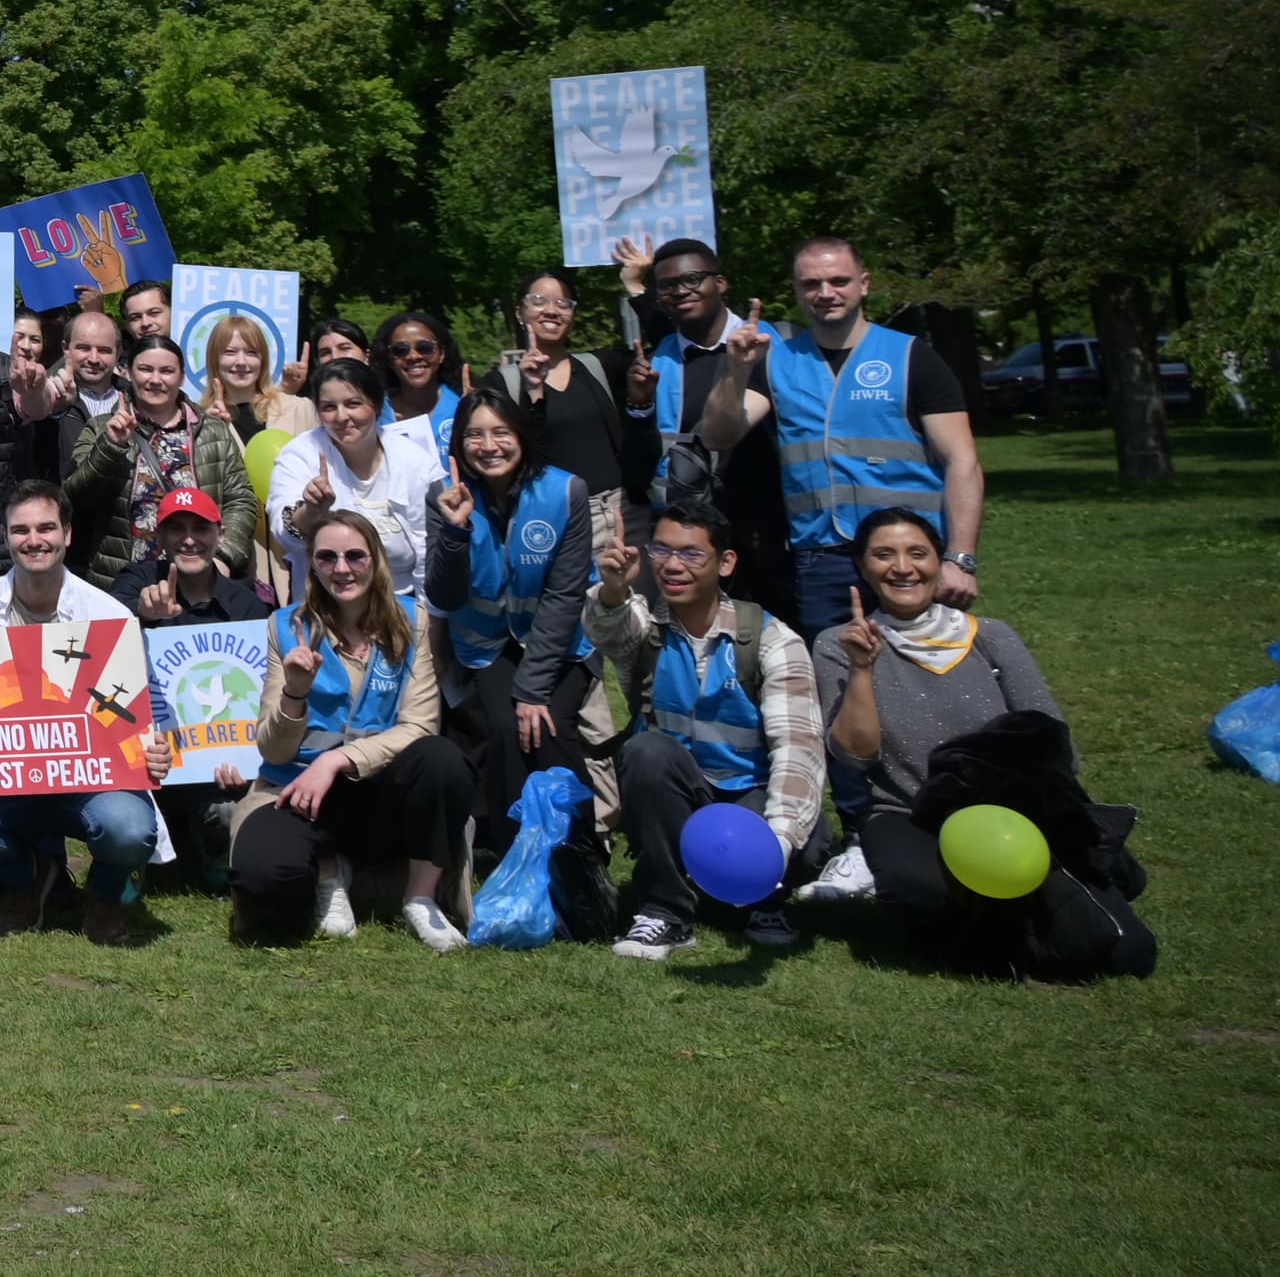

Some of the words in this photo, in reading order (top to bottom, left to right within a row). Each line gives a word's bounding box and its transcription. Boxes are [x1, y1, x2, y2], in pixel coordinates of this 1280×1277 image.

[179, 269, 291, 311] PEACE
[850, 389, 895, 401] HWPL
[155, 641, 192, 676] FOR
[29, 722, 78, 750] WAR
[175, 728, 200, 749] WE
[206, 723, 239, 744] ARE
[46, 757, 114, 787] PEACE
